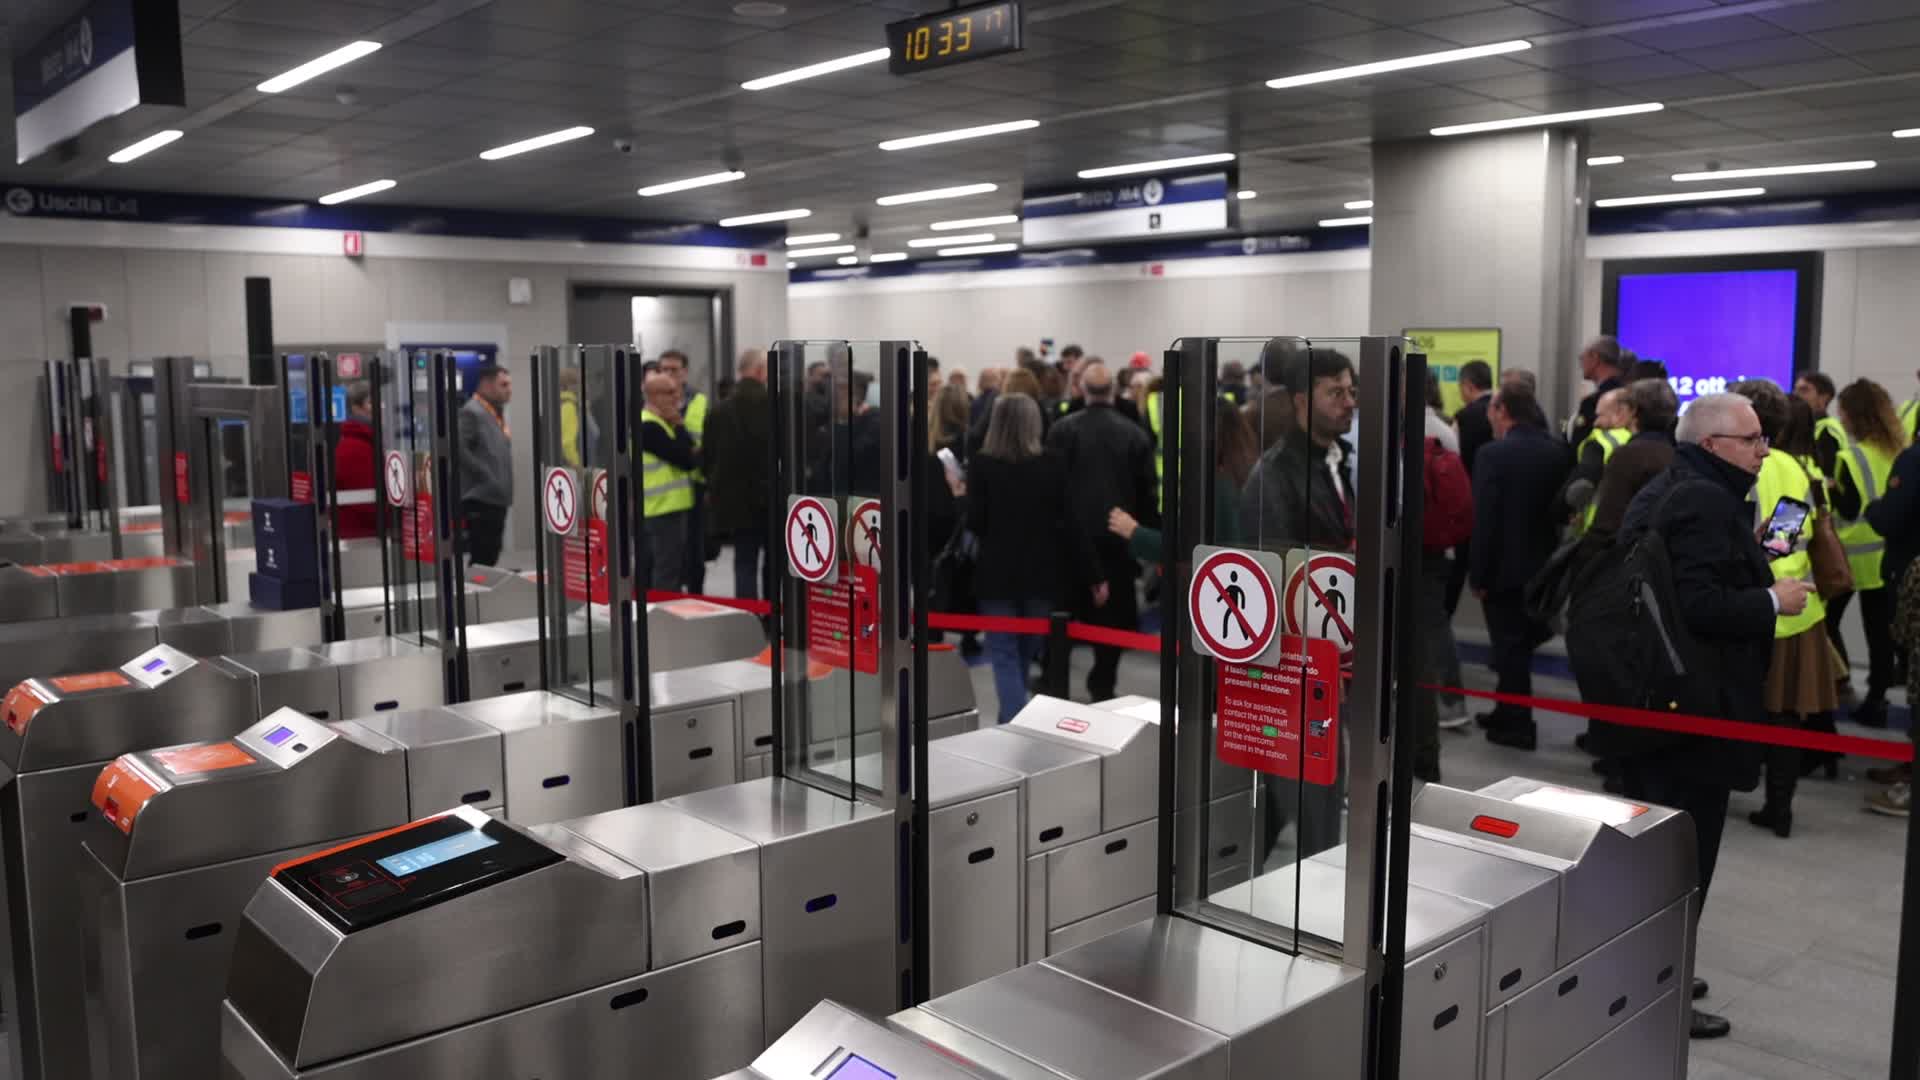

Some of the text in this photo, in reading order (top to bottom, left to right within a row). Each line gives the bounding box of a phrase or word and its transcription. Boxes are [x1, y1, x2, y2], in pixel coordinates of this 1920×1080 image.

[906, 27, 930, 62] 10
[938, 17, 971, 55] 33
[1230, 665, 1247, 676] tasto
[1262, 671, 1273, 680] dei
[1224, 677, 1252, 689] presenti
[1225, 696, 1231, 705] To
[1244, 700, 1253, 709] for
[1224, 708, 1288, 728] contact the ATM staff
[1224, 719, 1250, 731] pressing
[1250, 723, 1262, 733] the
[1278, 729, 1299, 741] button
[1232, 730, 1242, 739] the
[1243, 733, 1275, 746] intercoms
[1224, 741, 1288, 760] present in the station.
